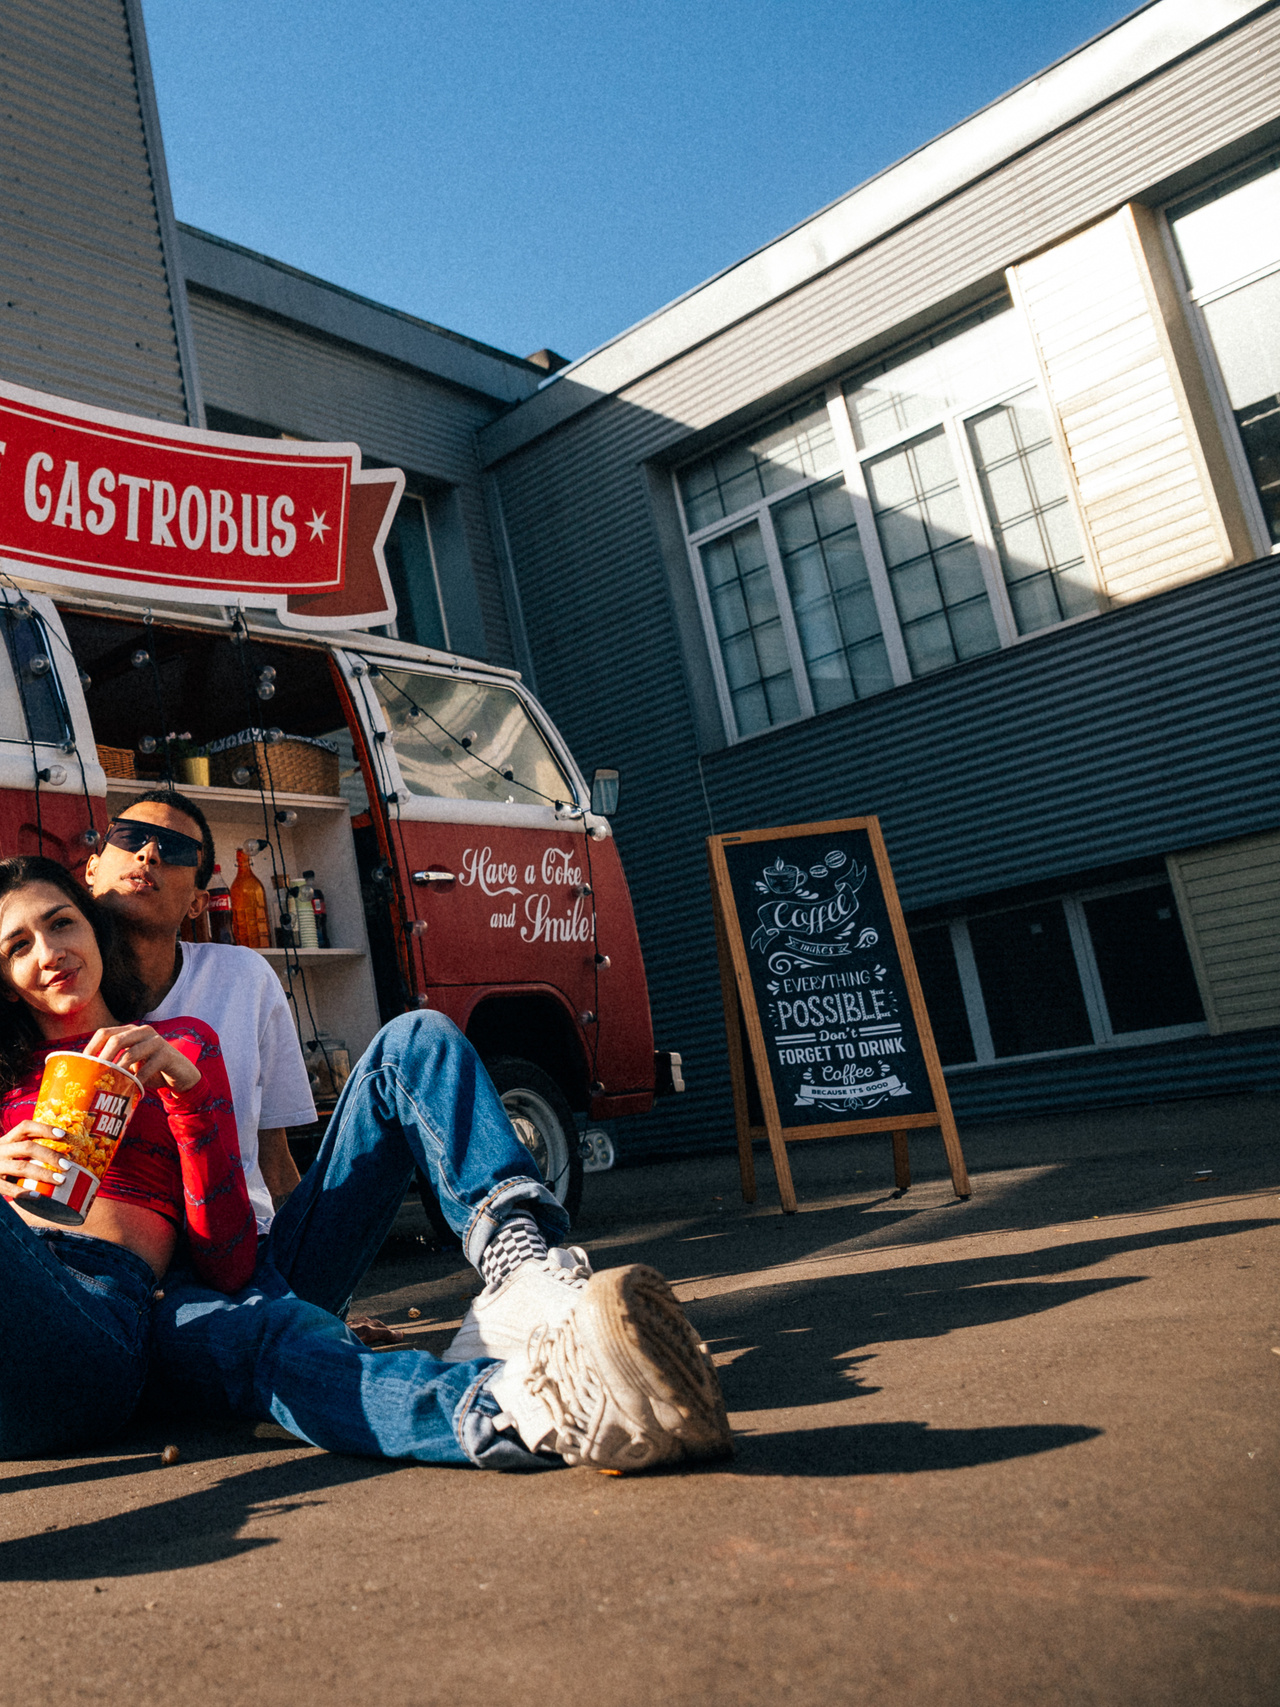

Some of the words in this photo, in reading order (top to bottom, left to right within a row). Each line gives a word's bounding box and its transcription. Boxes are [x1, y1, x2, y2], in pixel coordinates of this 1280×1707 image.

[24, 451, 297, 558] GASTROBUS
[459, 846, 523, 896] Have
[524, 864, 536, 885] a
[542, 848, 583, 886] Coke
[490, 903, 516, 929] and
[774, 894, 852, 935] Coffee
[800, 944, 834, 955] makes
[783, 970, 871, 994] EVERYTHING
[776, 989, 891, 1030] POSSIBLE
[818, 1028, 858, 1042] Don't
[778, 1046, 832, 1065] FORGET
[835, 1043, 856, 1060] TO
[860, 1037, 906, 1059] DRINK
[821, 1063, 875, 1086] Coffee
[849, 1087, 864, 1095] IT'S
[866, 1081, 889, 1092] GOOD
[94, 1093, 126, 1116] MIX
[96, 1114, 123, 1137] BAR
